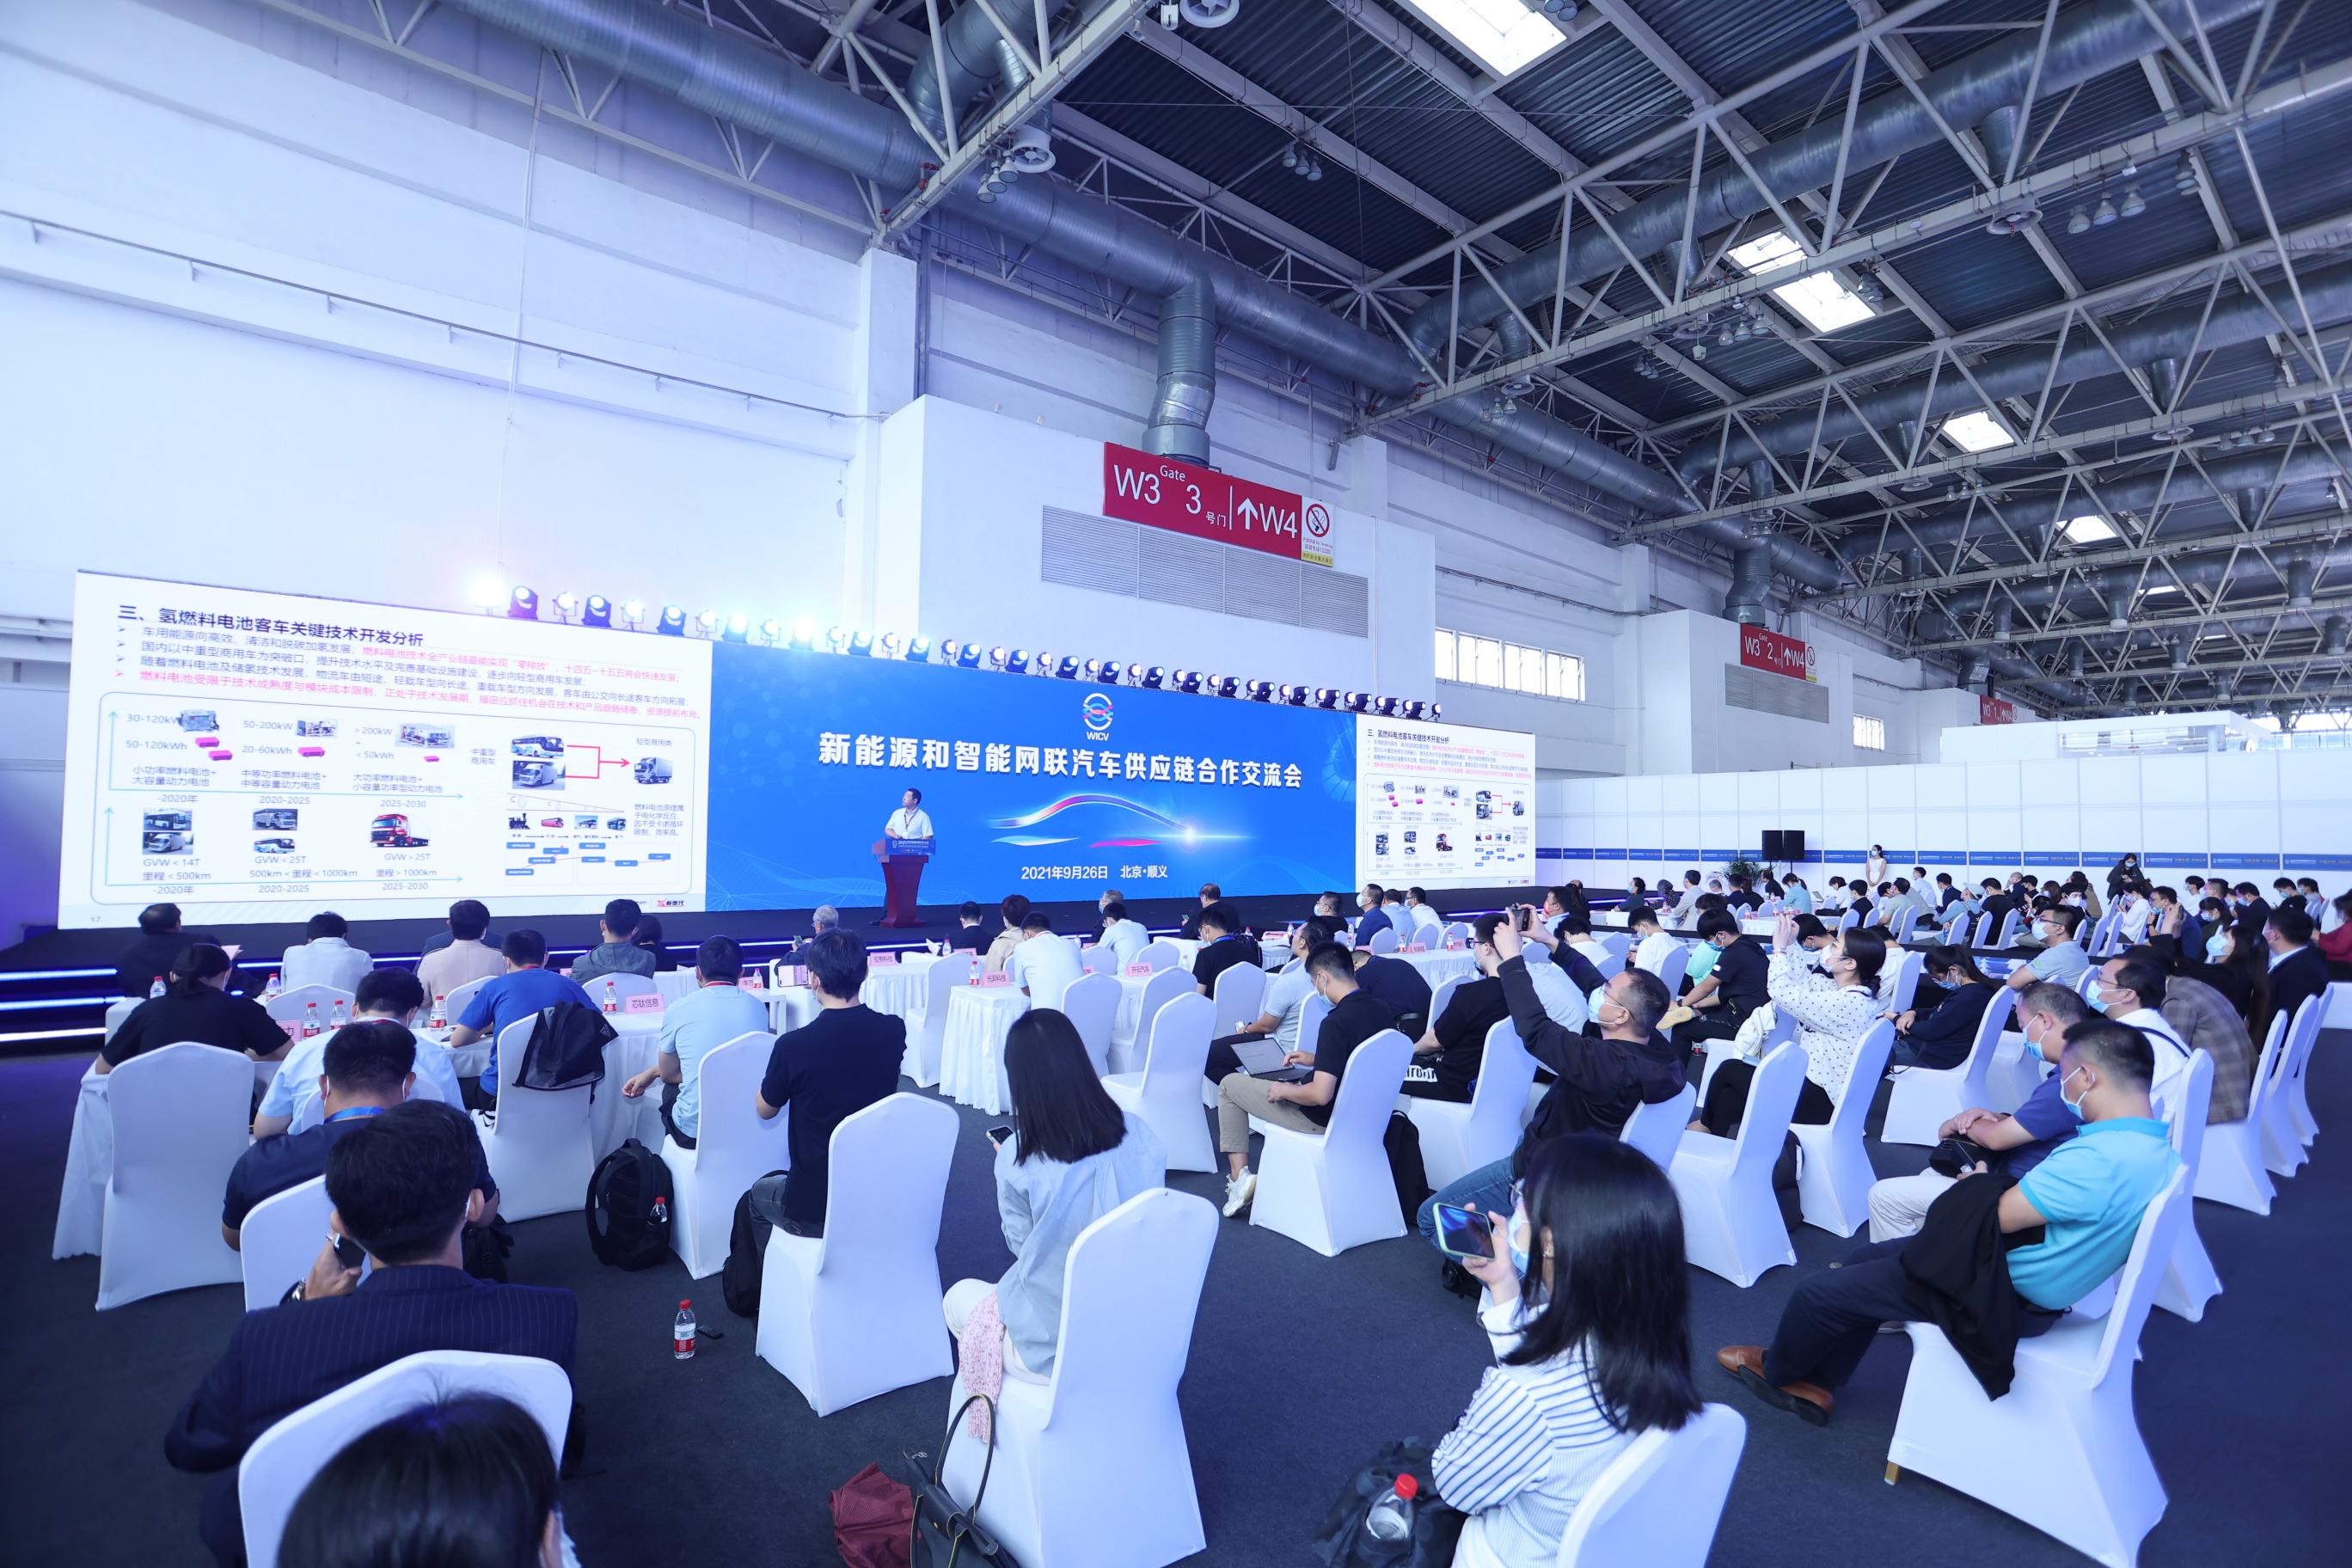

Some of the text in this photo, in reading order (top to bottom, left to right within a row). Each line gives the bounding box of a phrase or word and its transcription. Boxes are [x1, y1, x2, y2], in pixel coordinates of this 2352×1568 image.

[1114, 464, 1202, 514] W3 Gate 3
[1205, 511, 1227, 527] 号门
[1259, 503, 1297, 539] W4
[118, 604, 424, 647] 三、氢燃料电池客车关键技术开发分析
[1744, 634, 1773, 660] W3 Gate 2
[1791, 651, 1804, 669] W4
[243, 720, 293, 731] 50-200kW
[1086, 732, 1110, 741] WICV
[126, 739, 187, 750] 50-120kWh
[242, 744, 292, 755] 20-60kWh
[818, 731, 1303, 789] 新能源和智能网联汽车供应链合作交流会
[260, 795, 310, 805] 2020-2025
[380, 799, 426, 808] 2025-2030
[1020, 864, 1168, 881] 2021年9月26日 北京·顺义
[258, 885, 309, 893] 2020-2025
[382, 882, 428, 891] 2025-2030
